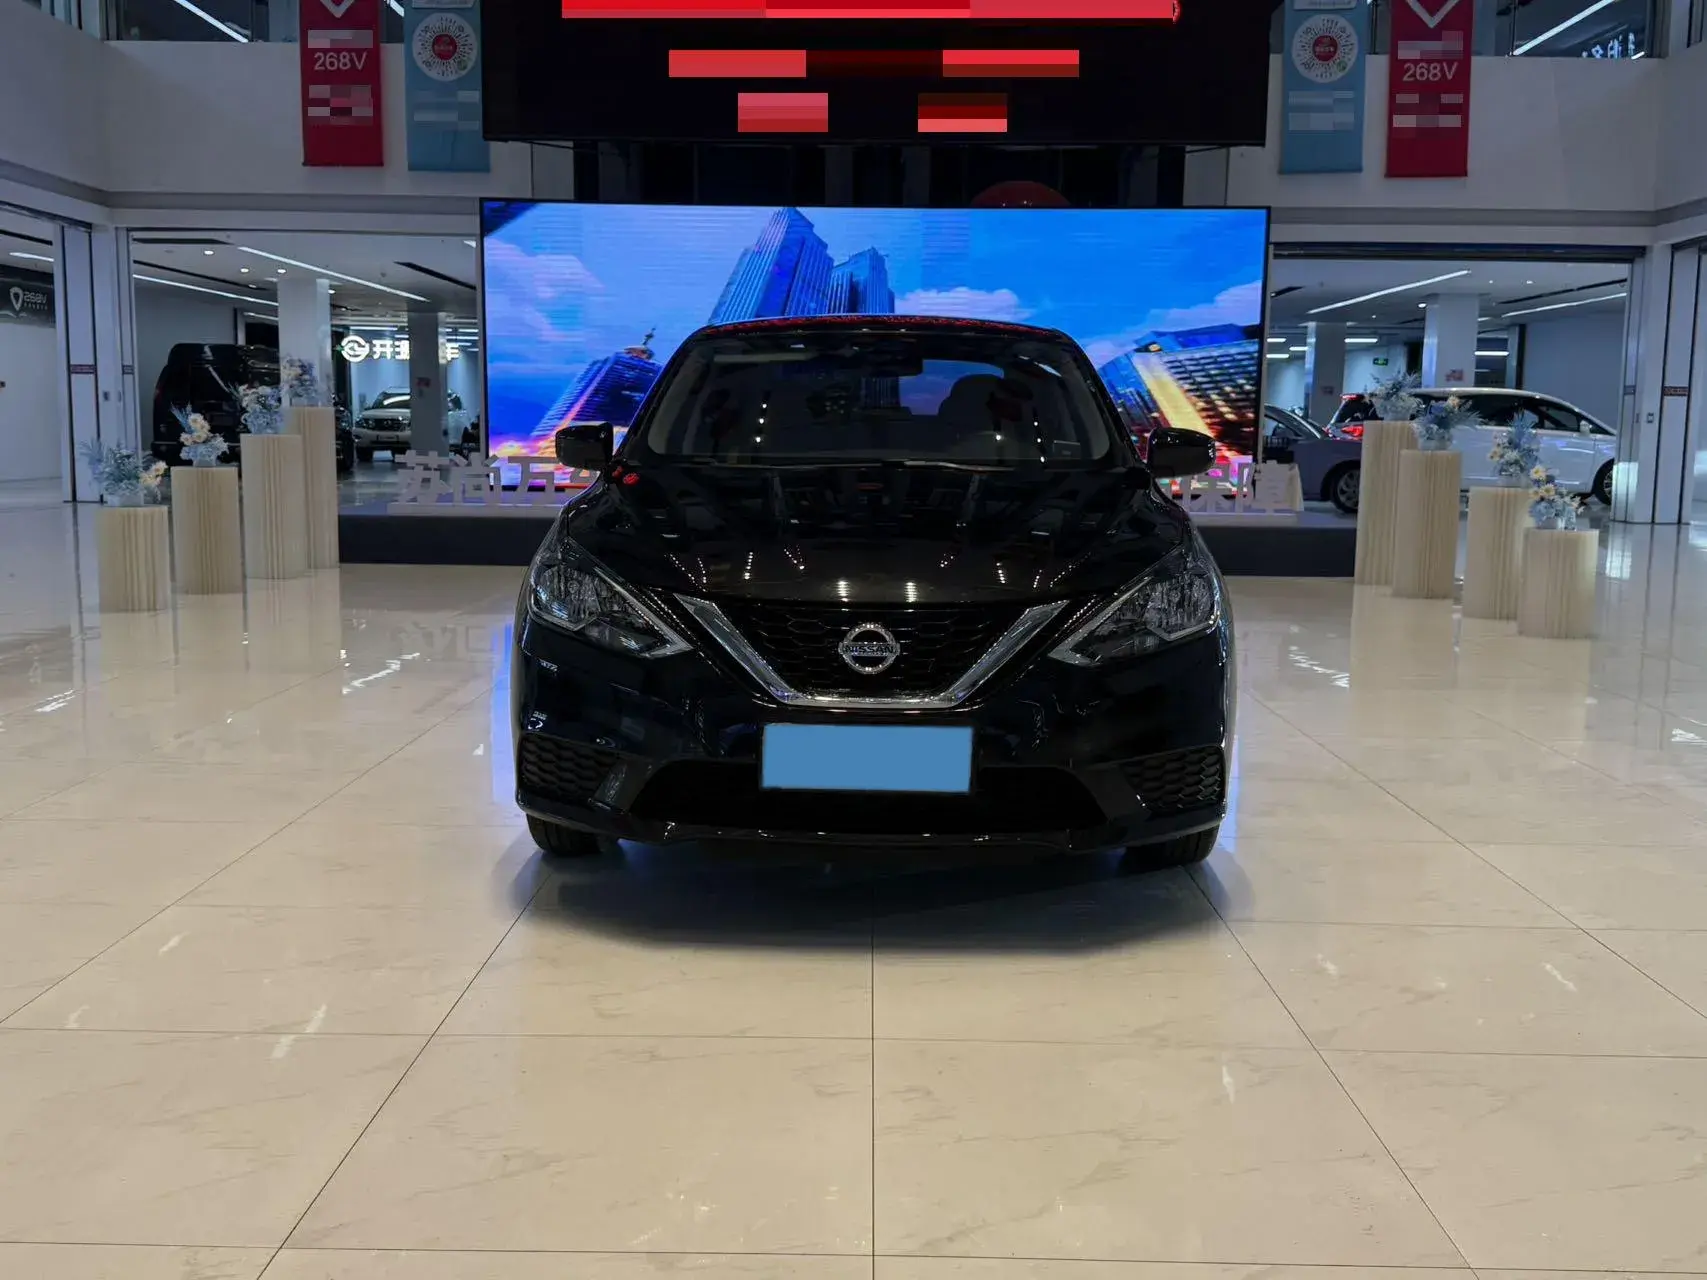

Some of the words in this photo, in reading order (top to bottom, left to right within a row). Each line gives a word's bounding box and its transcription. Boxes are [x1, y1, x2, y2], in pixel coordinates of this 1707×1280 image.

[313, 51, 368, 71] 268V
[1402, 61, 1459, 82] 268V
[843, 644, 896, 655] NISSAN
